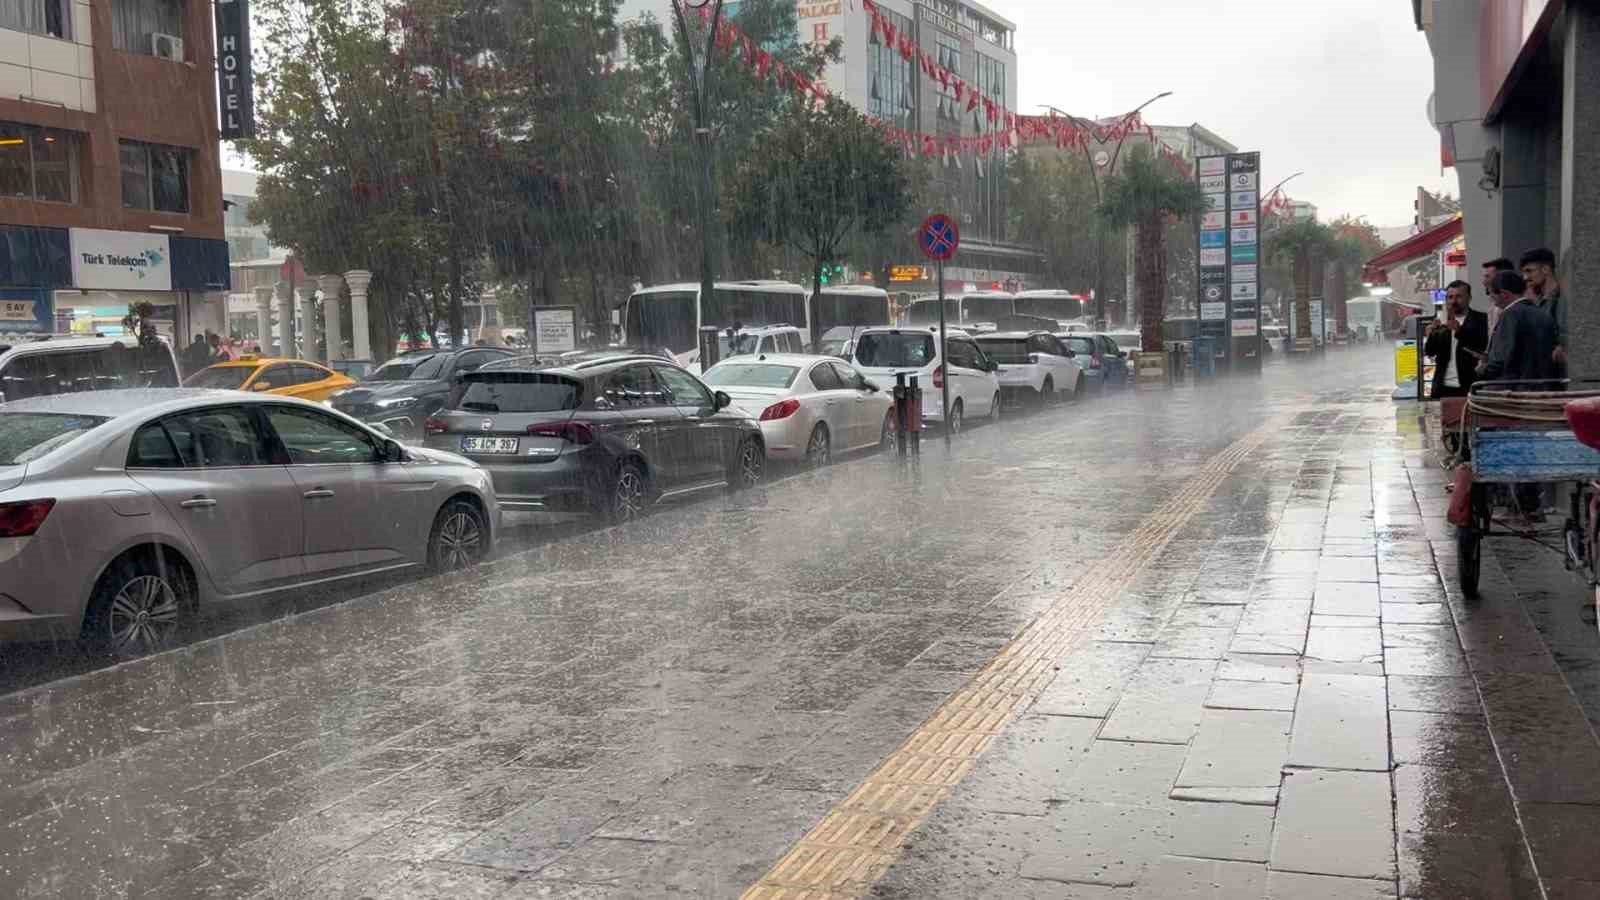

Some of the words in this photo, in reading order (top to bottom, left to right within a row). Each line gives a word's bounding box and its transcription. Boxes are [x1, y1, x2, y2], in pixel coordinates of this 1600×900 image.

[223, 35, 239, 129] HOTEL
[82, 252, 105, 265] Türk
[106, 254, 147, 267] Telekom
